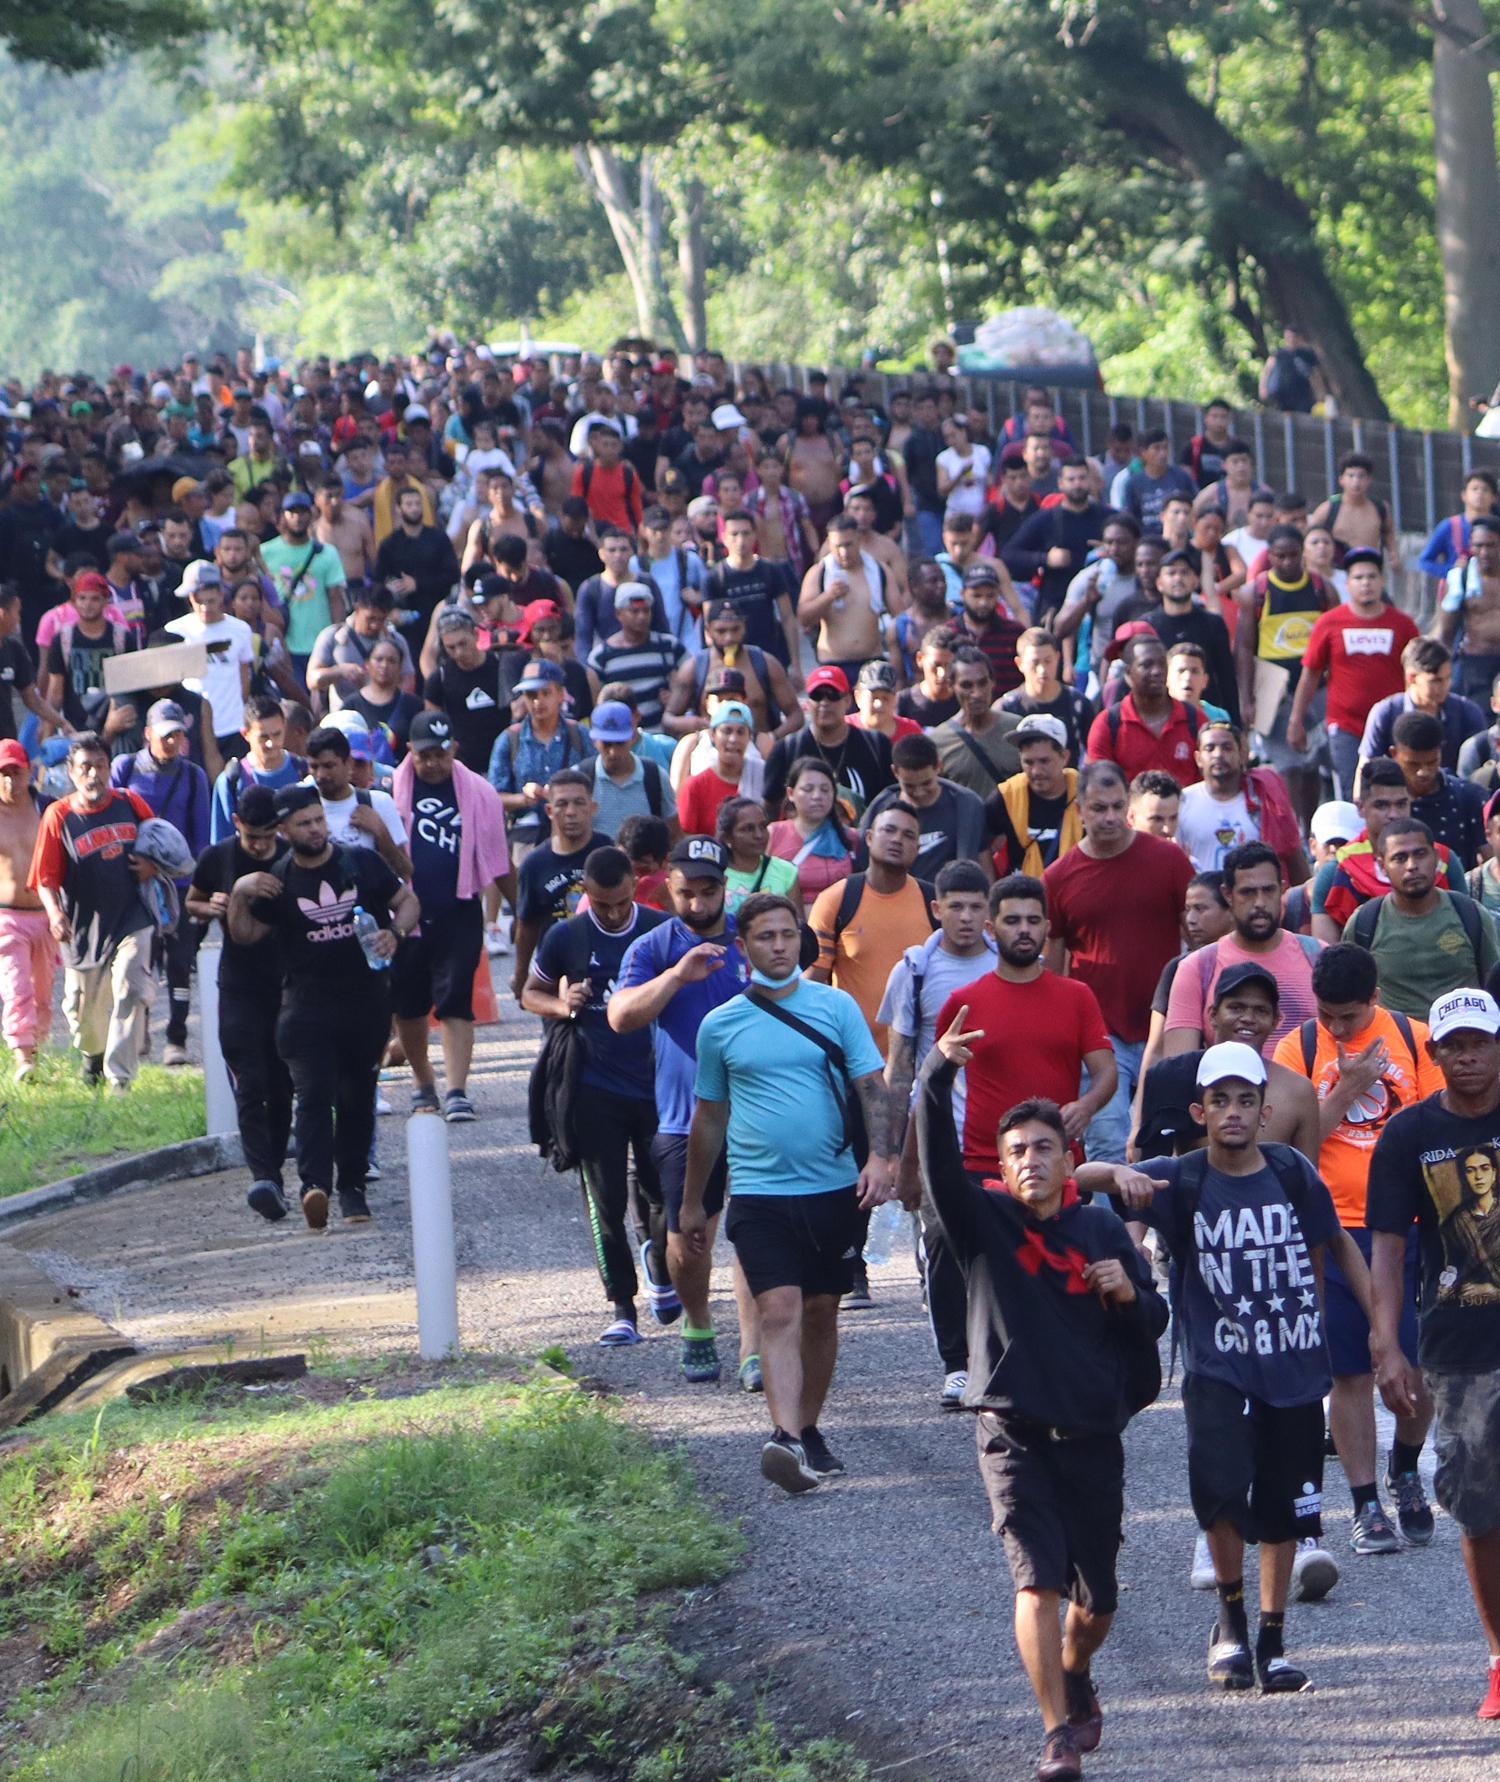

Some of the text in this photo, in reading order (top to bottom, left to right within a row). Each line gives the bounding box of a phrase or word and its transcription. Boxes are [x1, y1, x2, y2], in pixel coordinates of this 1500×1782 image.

[416, 797, 462, 827] GIV
[417, 817, 461, 854] CH
[688, 840, 721, 863] CAT
[306, 923, 355, 942] adida
[1438, 997, 1487, 1020] CHICAGO
[1193, 1202, 1304, 1249] MADE
[1242, 1243, 1315, 1292] THE
[1254, 1319, 1274, 1355] &
[1278, 1311, 1321, 1352] MX
